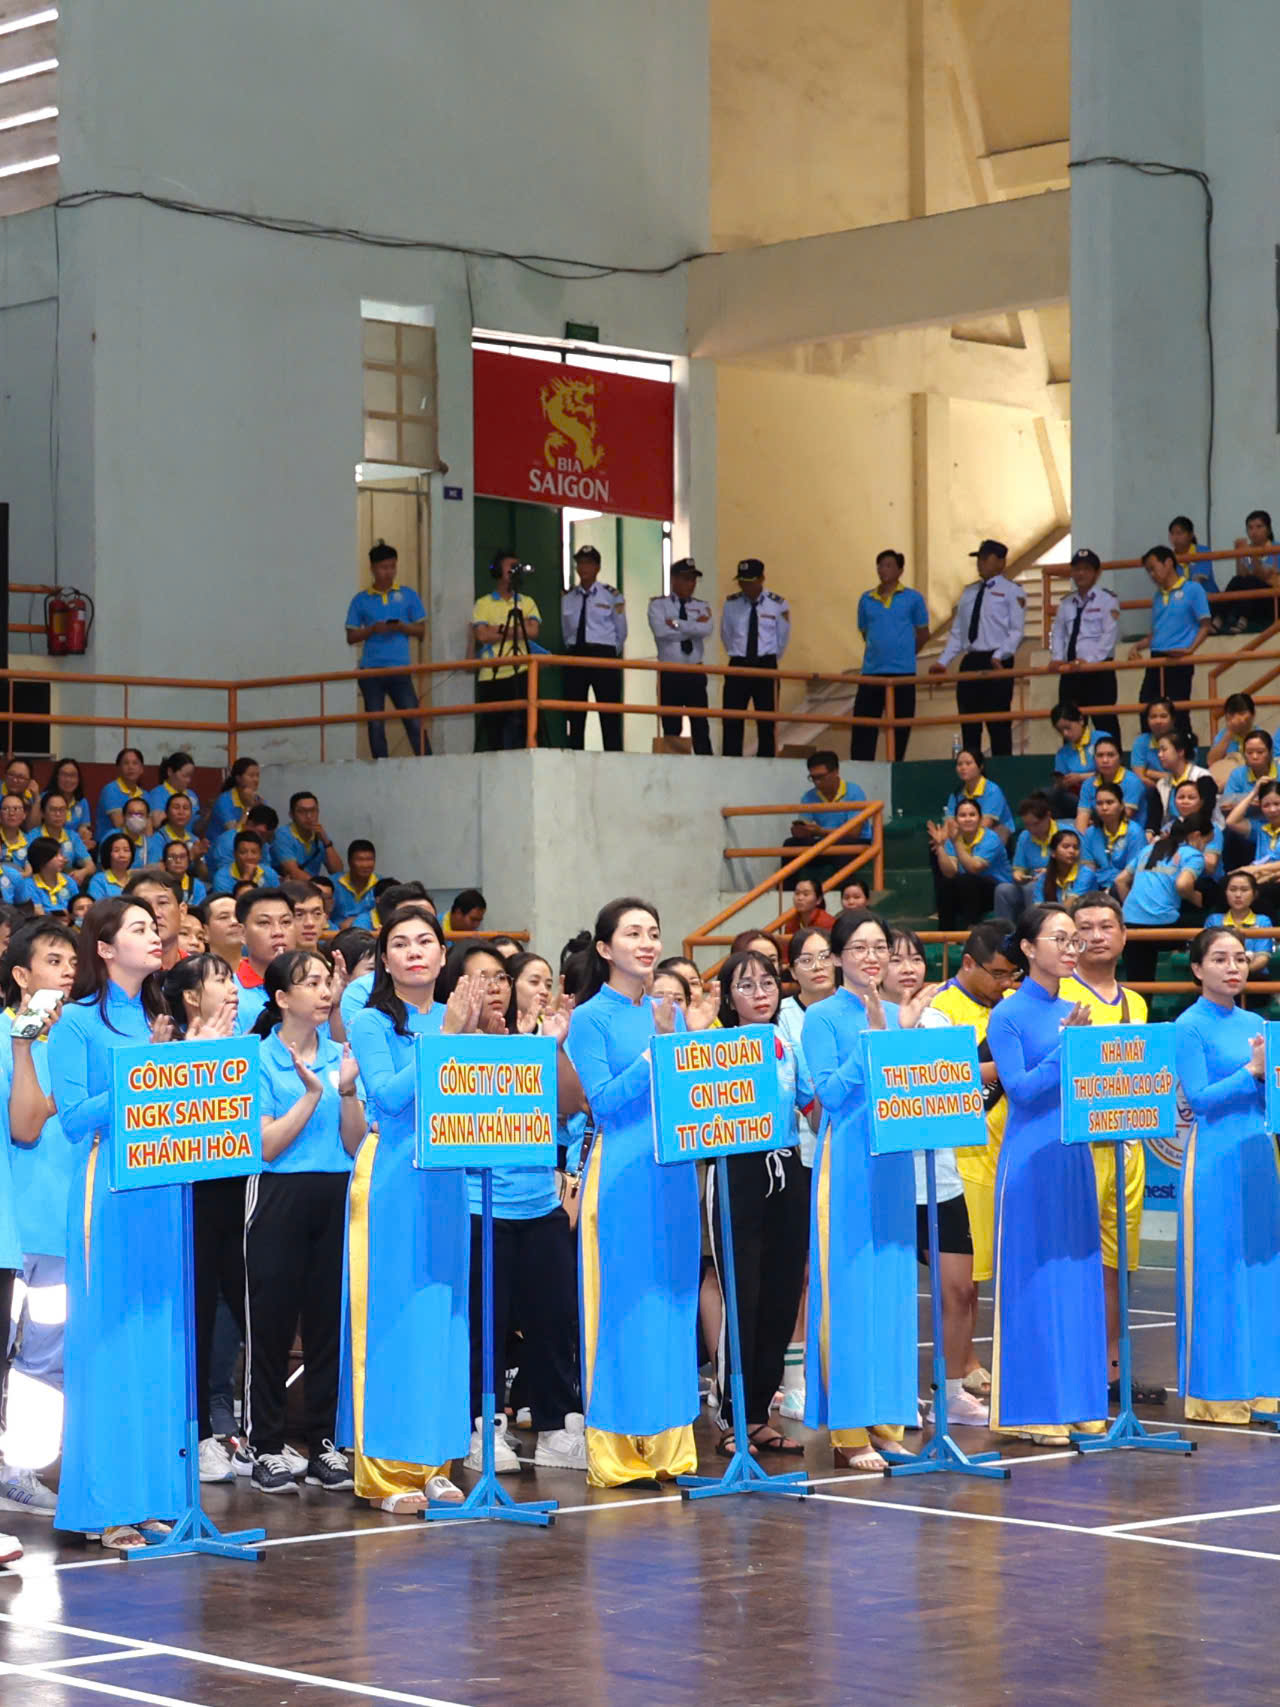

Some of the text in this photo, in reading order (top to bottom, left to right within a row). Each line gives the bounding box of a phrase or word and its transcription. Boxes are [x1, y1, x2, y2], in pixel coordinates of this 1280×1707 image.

[558, 457, 582, 473] BIA
[529, 468, 610, 503] SAIGON
[675, 1037, 762, 1071] LIÊN QUÂN
[1102, 1036, 1145, 1062] NHÀ MÁY
[129, 1059, 247, 1090] CÔNG TY CP
[440, 1058, 542, 1093] CÔNG TY CP NGK
[883, 1060, 971, 1090] THỊ TRƯỜNG
[1074, 1074, 1101, 1103] THỰC
[1132, 1073, 1152, 1095] CAO
[1153, 1065, 1172, 1094] CẤP
[691, 1080, 754, 1109] CN HCM
[878, 1089, 982, 1119] ĐÔNG NAM BỘ
[126, 1096, 252, 1130] NGK SANEST
[431, 1107, 551, 1143] SANNA KHÁNH HÒA
[1089, 1107, 1158, 1132] SANEST FOODS
[677, 1113, 772, 1149] TT CẦN THƠ
[128, 1131, 251, 1167] KHÁNH HÒA
[1144, 1183, 1176, 1199] nest
